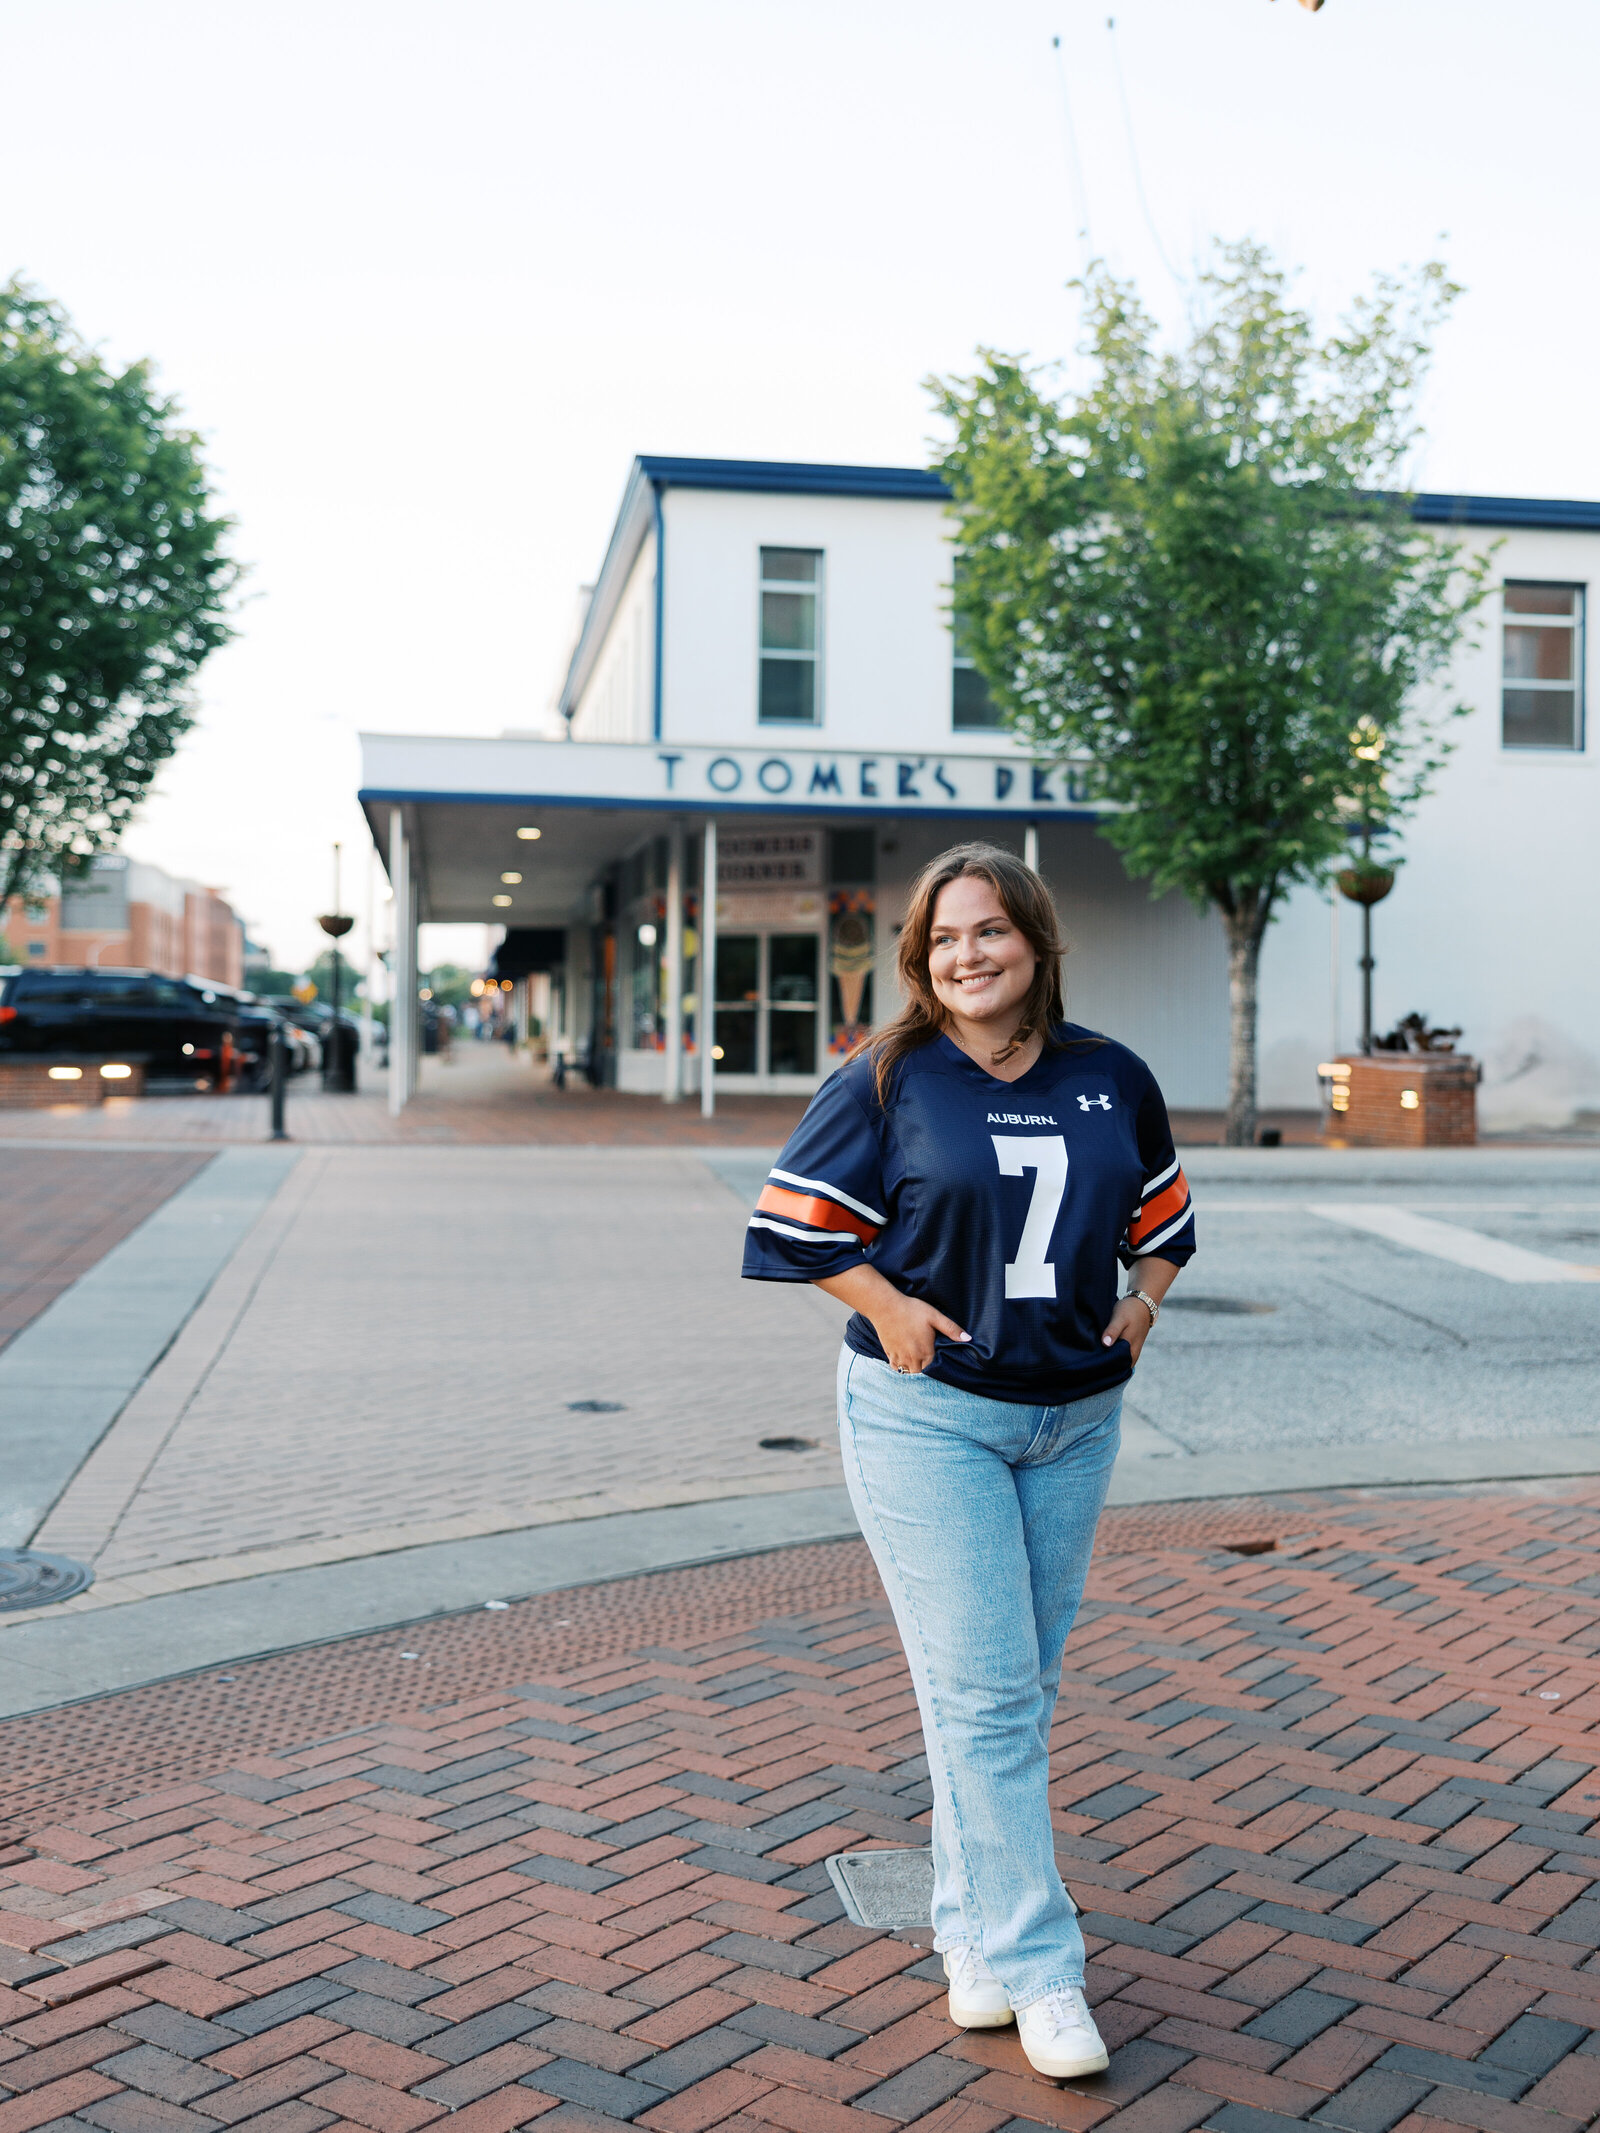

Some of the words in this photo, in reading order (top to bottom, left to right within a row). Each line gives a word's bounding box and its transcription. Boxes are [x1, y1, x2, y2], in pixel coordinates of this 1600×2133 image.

[657, 754, 956, 799] TOOMER'S
[995, 765, 1092, 803] DRU
[990, 1134, 1069, 1299] 7
